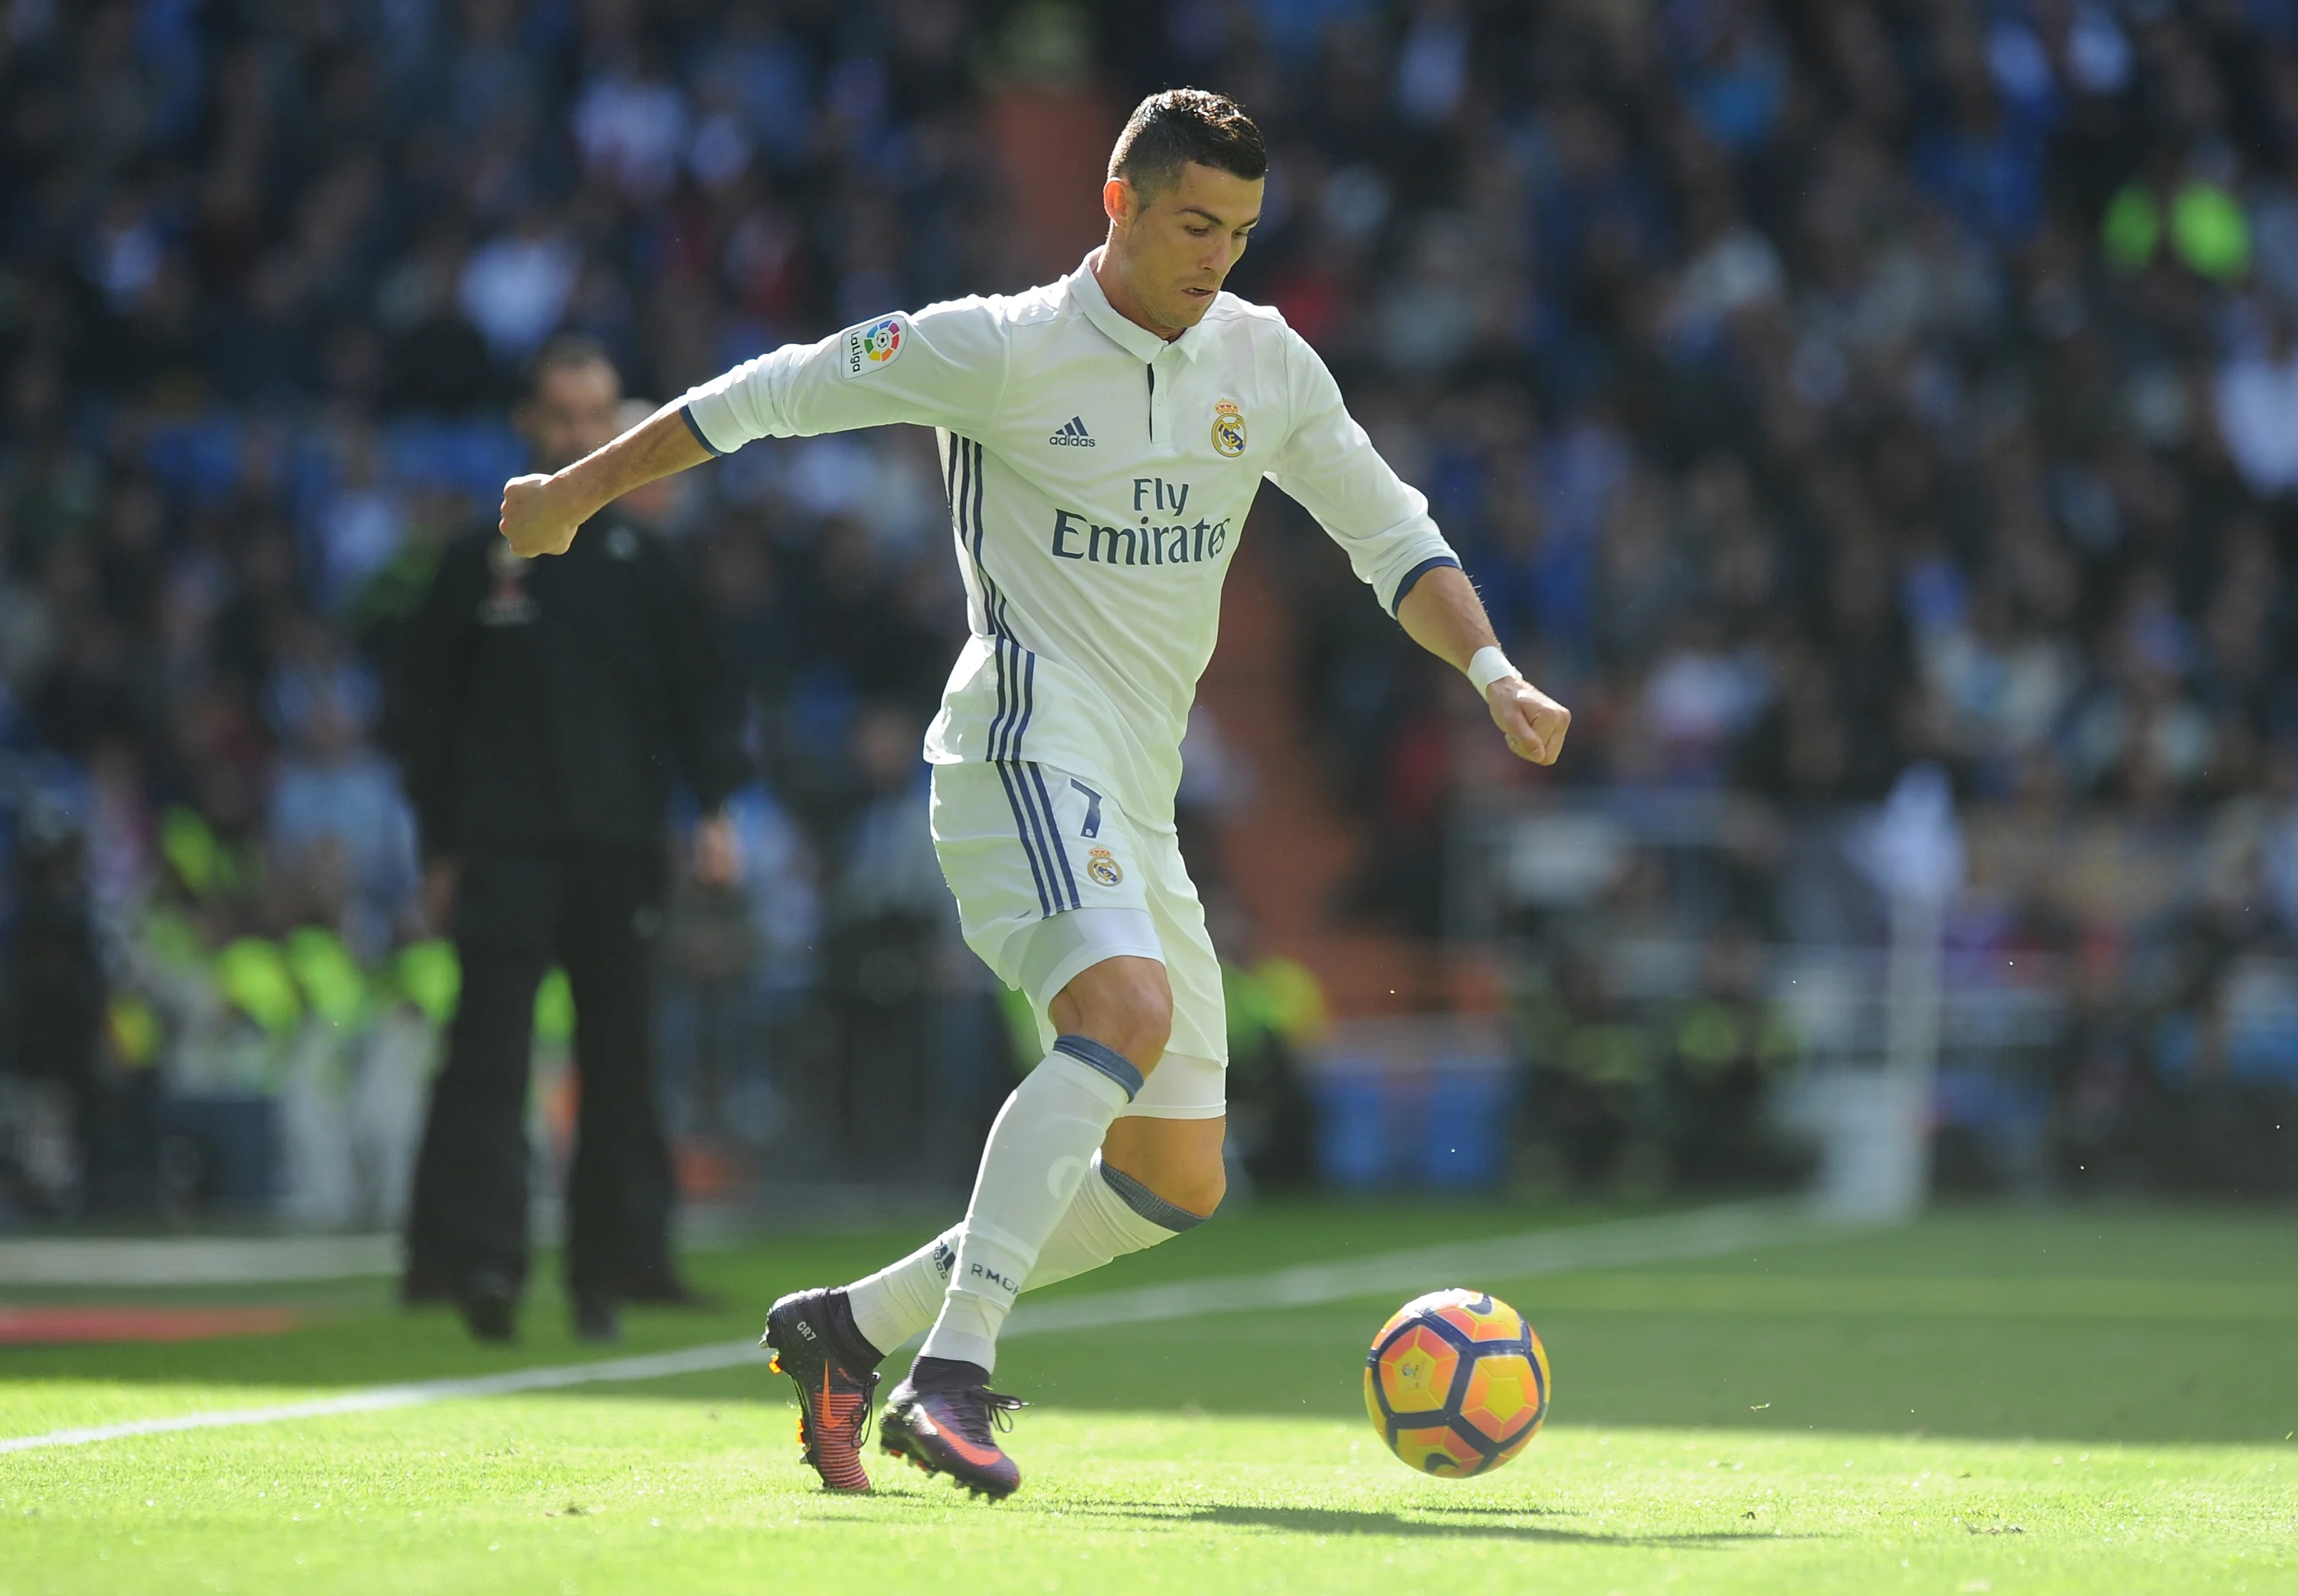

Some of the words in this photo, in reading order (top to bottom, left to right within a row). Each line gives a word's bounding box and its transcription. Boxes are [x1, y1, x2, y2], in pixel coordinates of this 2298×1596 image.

[850, 331, 863, 372] LaLiga
[1049, 434, 1095, 447] adidas
[1133, 478, 1189, 516] Fly
[1052, 508, 1231, 565] Emirates
[1071, 777, 1102, 839] 7
[797, 1321, 817, 1341] CR7
